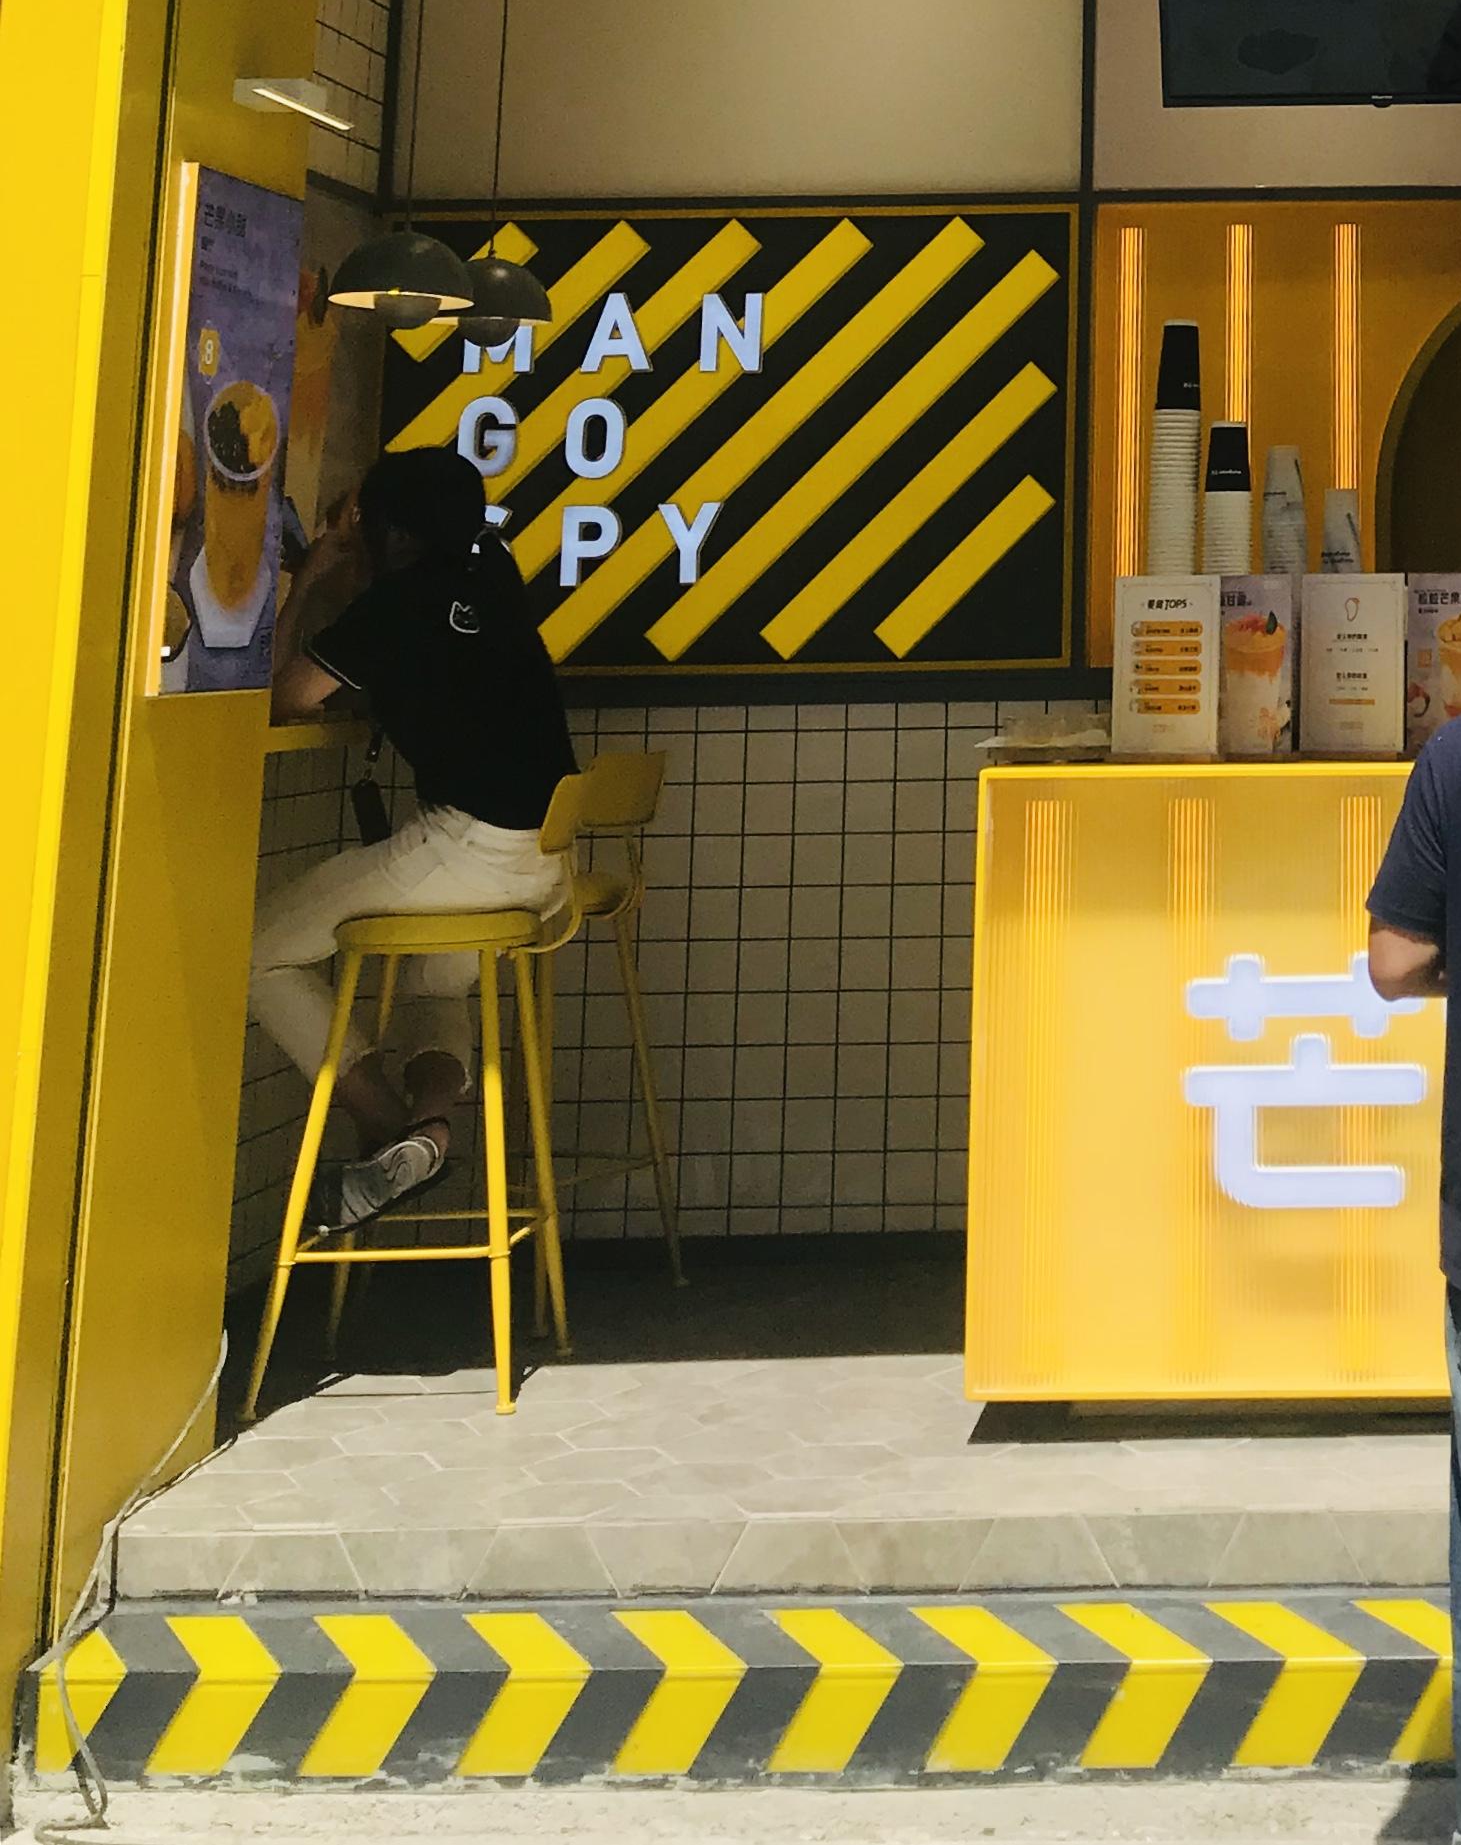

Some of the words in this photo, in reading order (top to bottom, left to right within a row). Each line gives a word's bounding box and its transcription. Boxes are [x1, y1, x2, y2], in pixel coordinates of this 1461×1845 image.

[457, 396, 626, 479] GO
[470, 501, 722, 587] PY
[1183, 952, 1427, 1209] 芒
